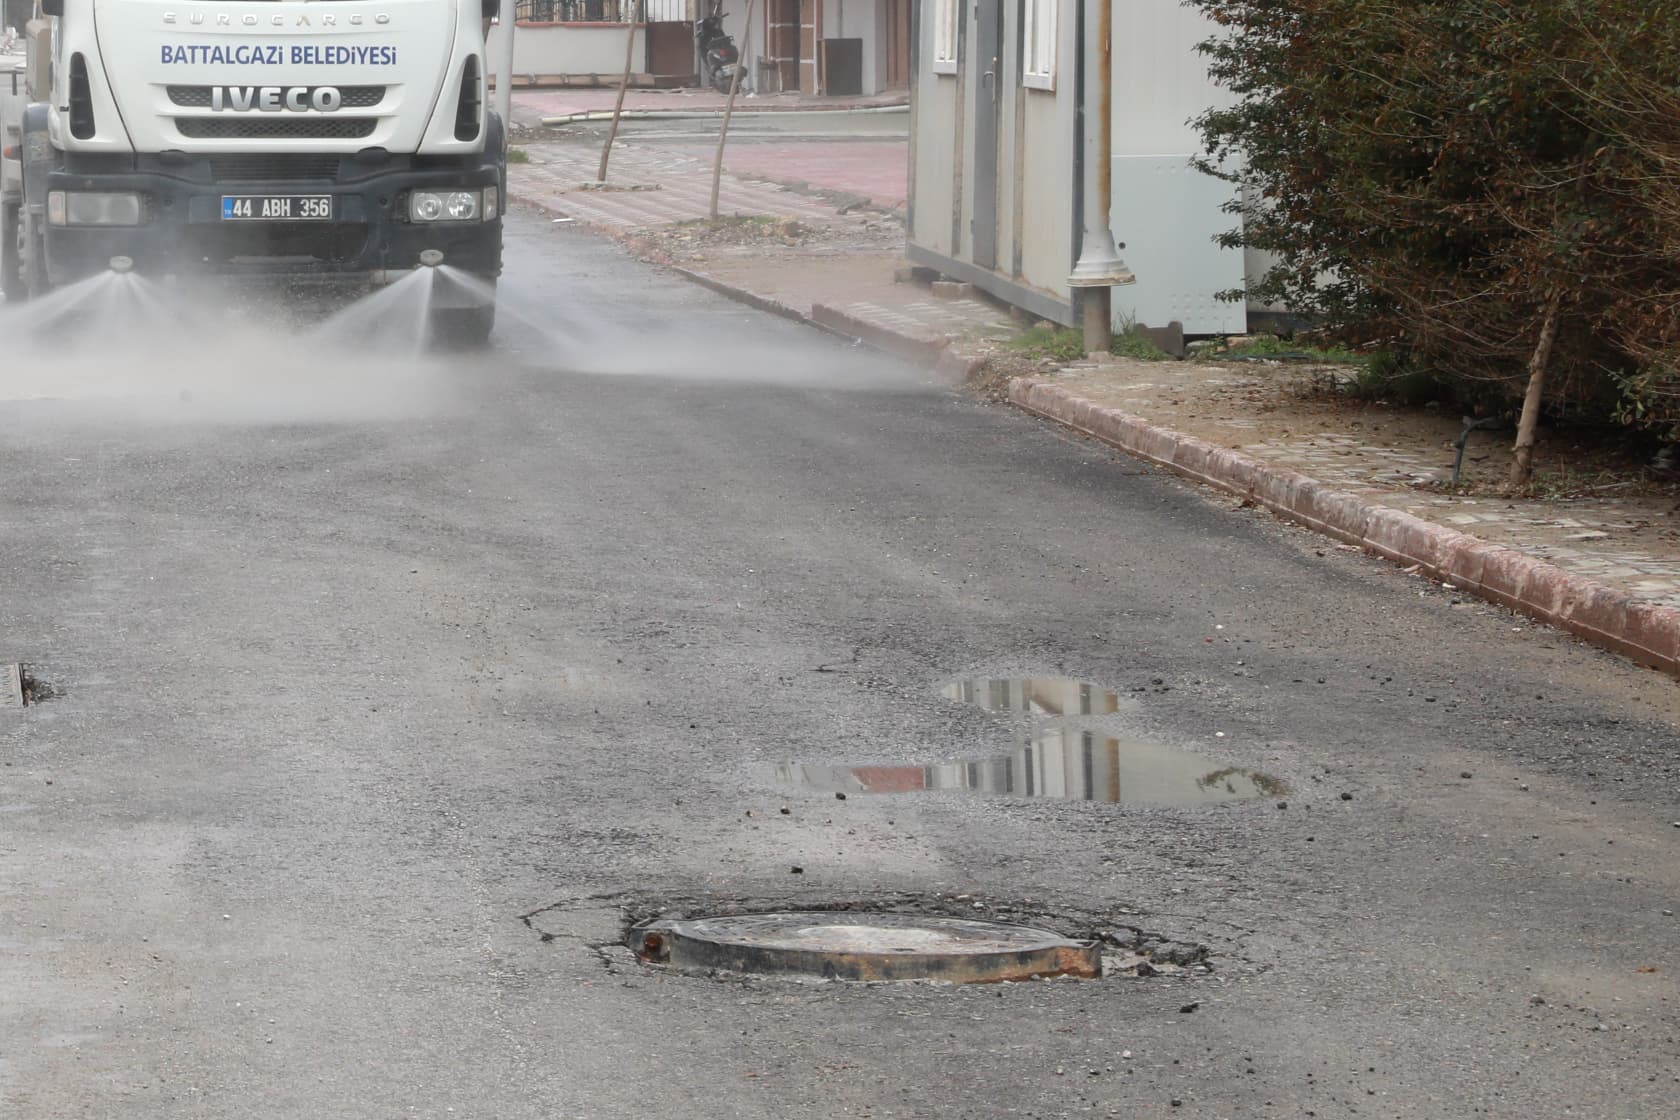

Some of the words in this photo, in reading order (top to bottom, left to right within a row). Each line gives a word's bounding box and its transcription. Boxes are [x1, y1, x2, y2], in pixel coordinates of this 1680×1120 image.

[212, 86, 341, 112] IVECO
[233, 199, 252, 217] 44
[261, 199, 291, 217] ABH
[300, 199, 329, 217] 356
